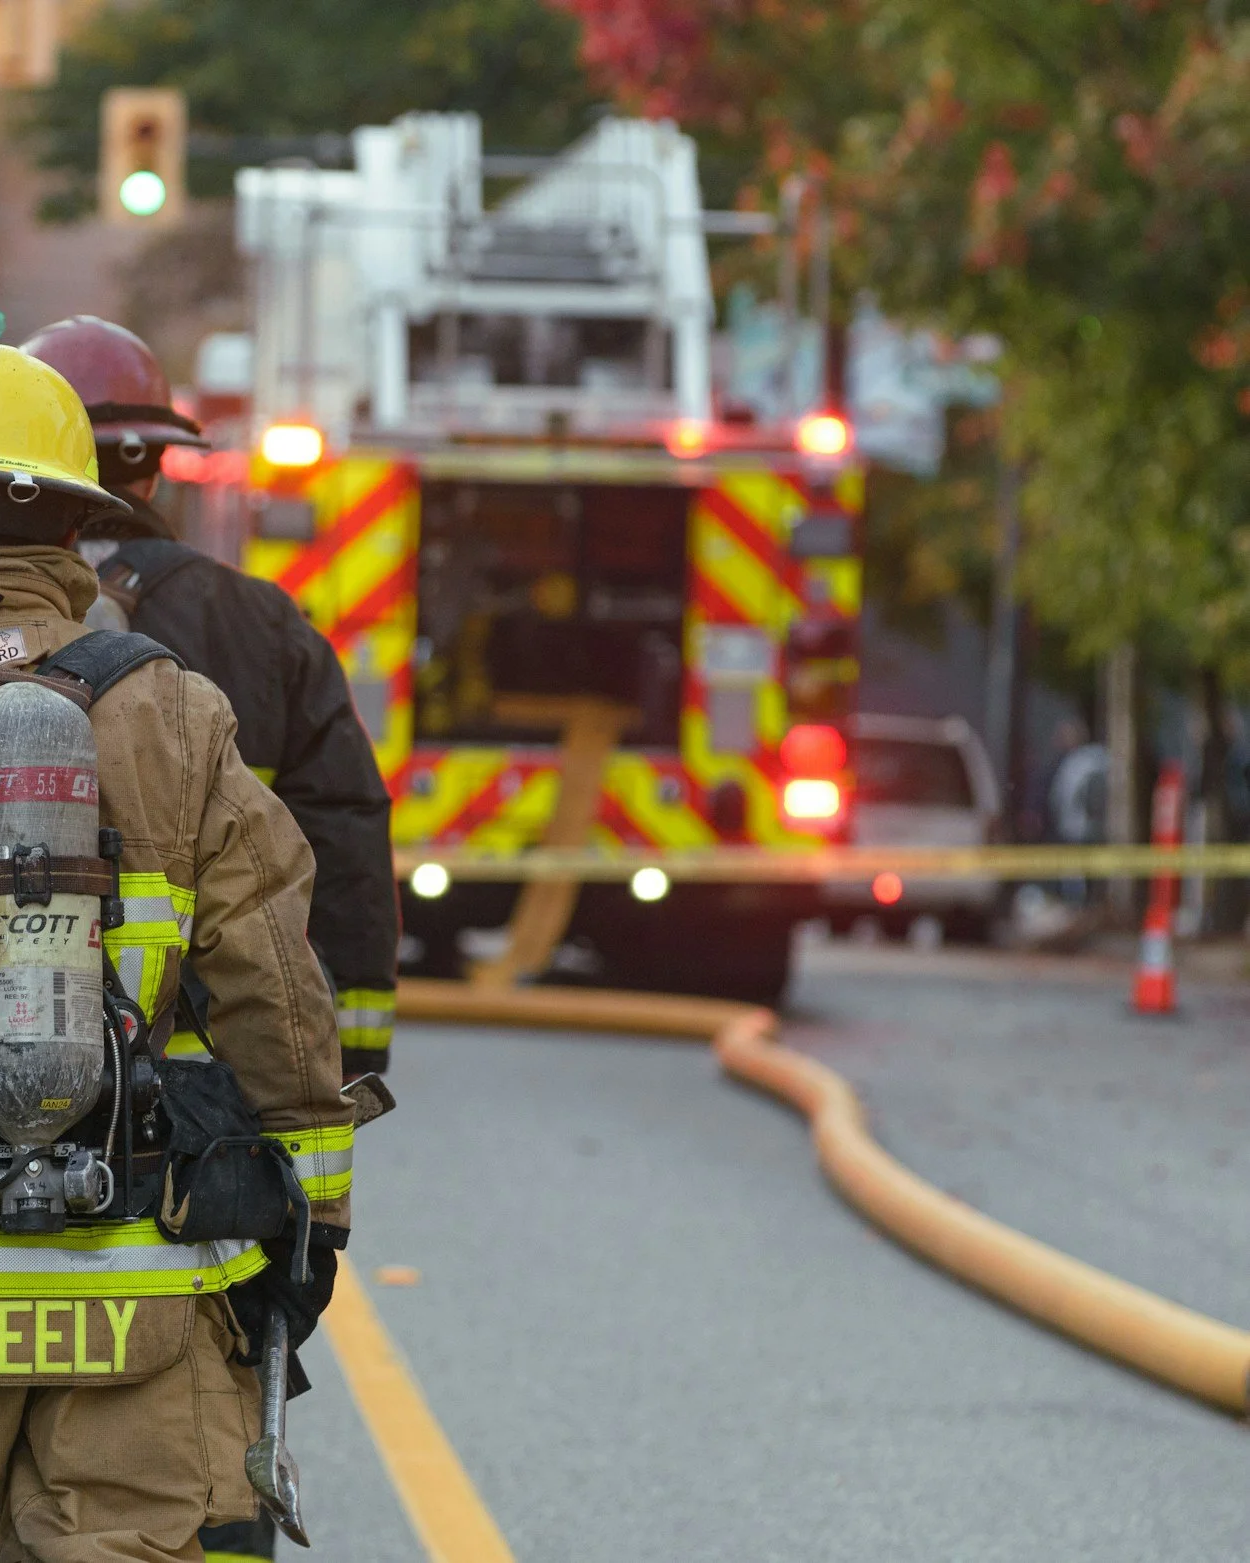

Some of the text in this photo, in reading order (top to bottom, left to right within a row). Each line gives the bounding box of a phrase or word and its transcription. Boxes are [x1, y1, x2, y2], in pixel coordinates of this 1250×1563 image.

[1, 914, 80, 935] COTT
[16, 937, 70, 945] FETY
[41, 1100, 68, 1109] JAN24
